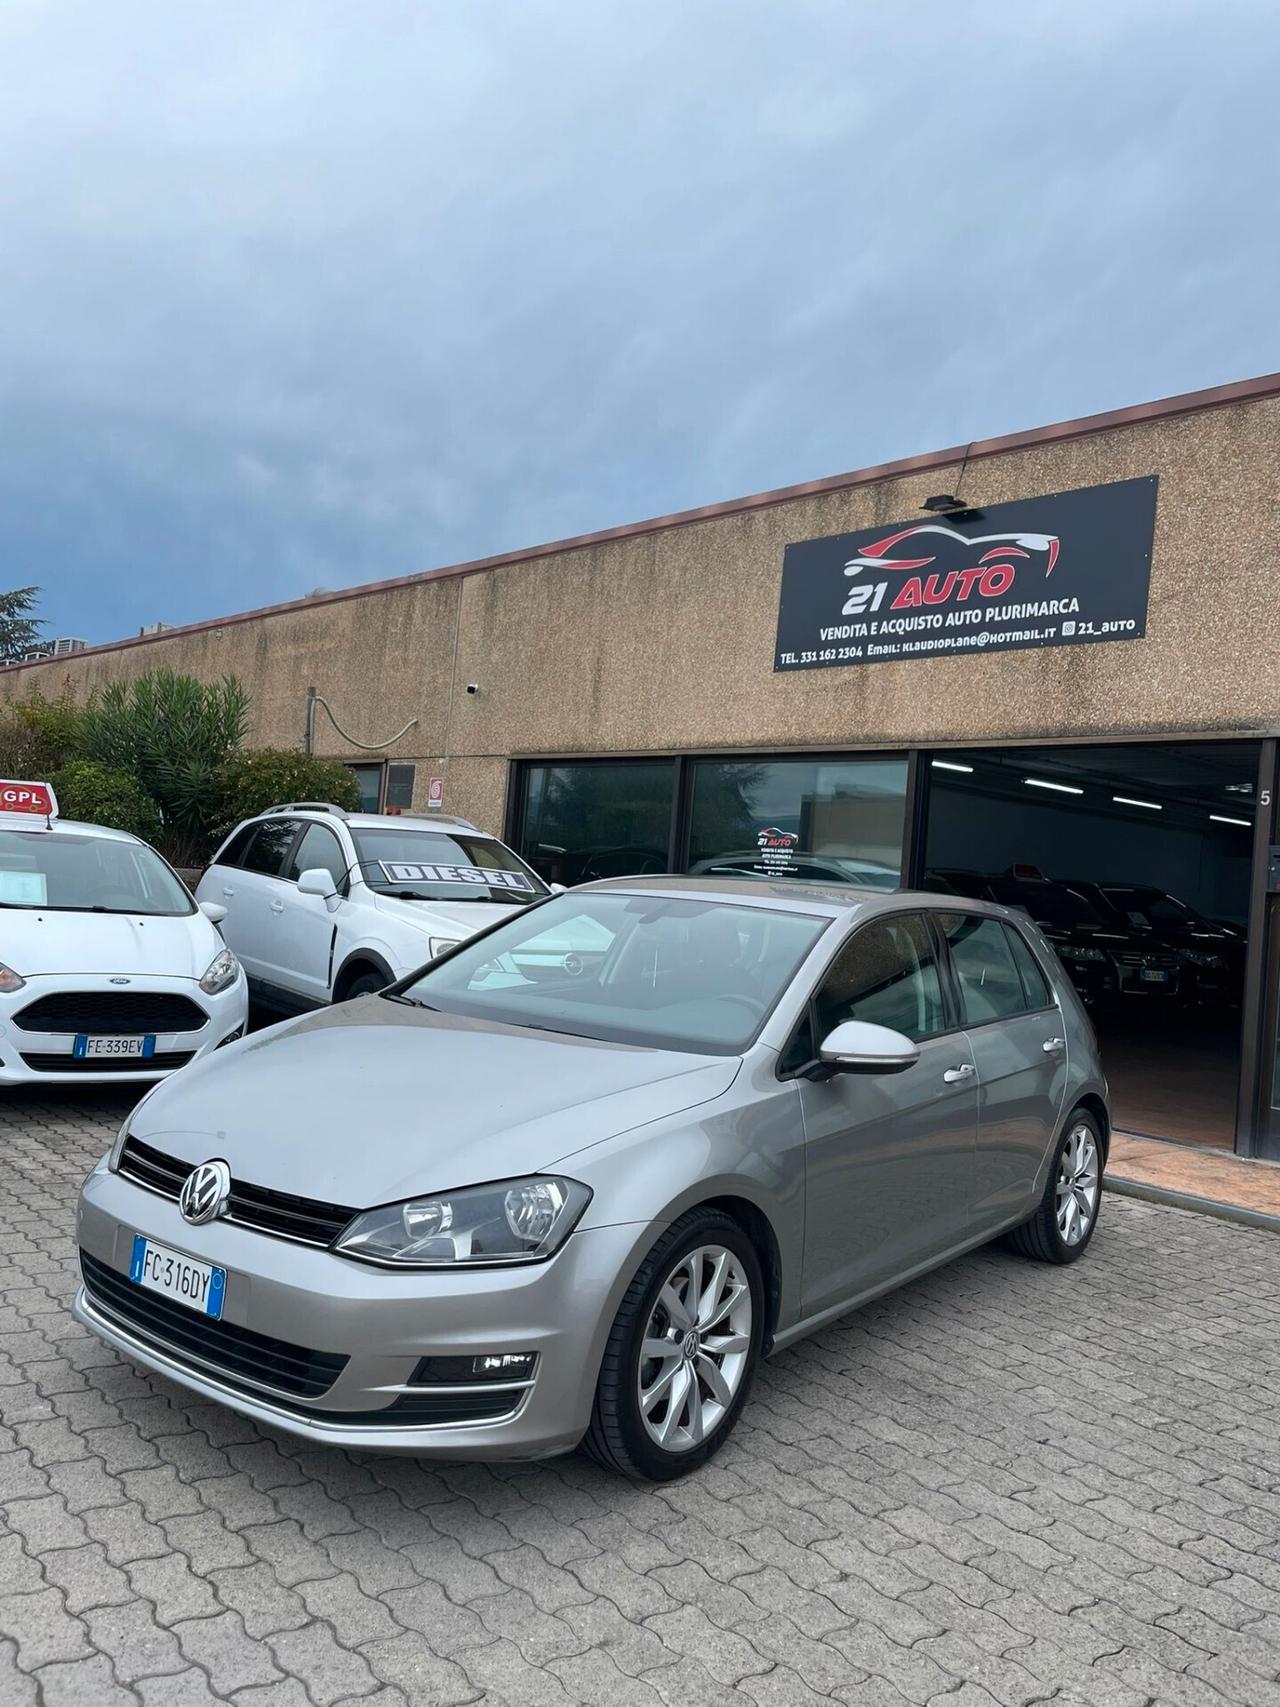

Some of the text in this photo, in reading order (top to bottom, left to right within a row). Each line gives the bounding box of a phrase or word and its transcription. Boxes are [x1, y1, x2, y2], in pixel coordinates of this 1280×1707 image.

[842, 564, 1016, 615] 21 AUTO
[820, 597, 1080, 641] VENDITA E ACQUISTO AUTO PLURIMARCA
[780, 653, 799, 665] TEL.
[800, 651, 818, 663] 331
[819, 649, 837, 661] 162
[838, 647, 863, 660] 2304
[4, 790, 42, 804] GPL
[1260, 790, 1270, 805] 5
[391, 865, 525, 888] DIESEL
